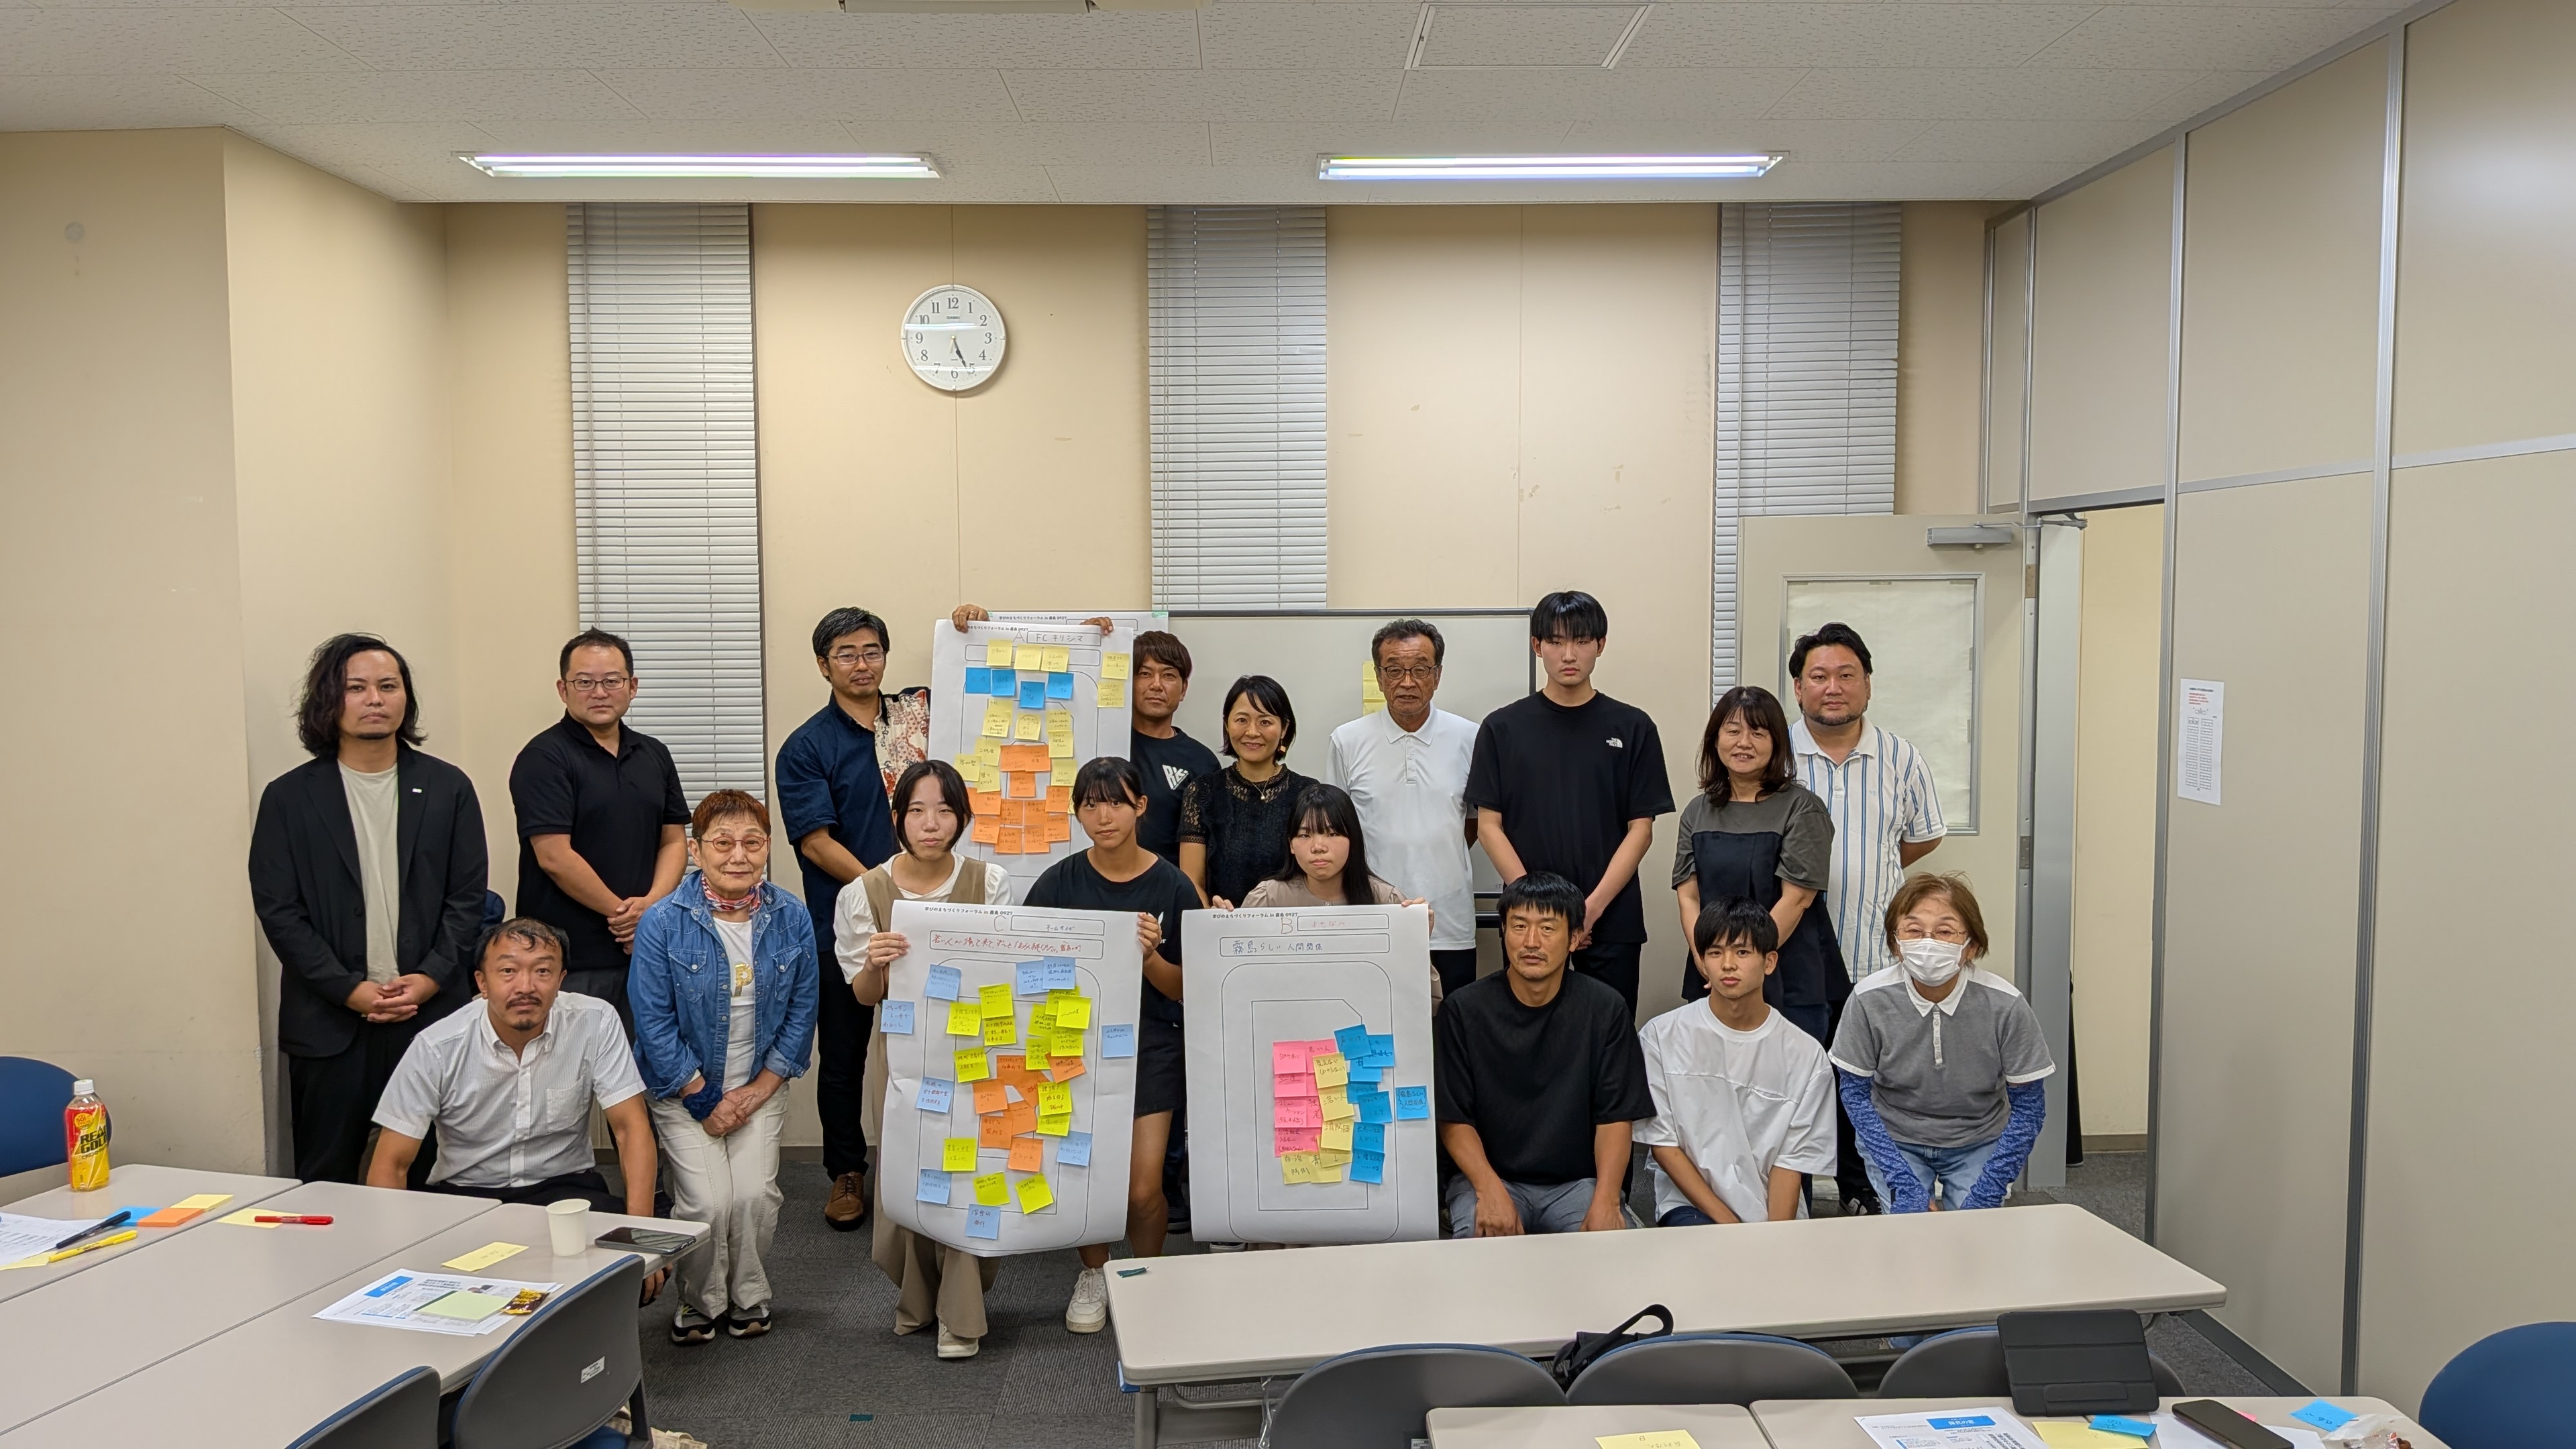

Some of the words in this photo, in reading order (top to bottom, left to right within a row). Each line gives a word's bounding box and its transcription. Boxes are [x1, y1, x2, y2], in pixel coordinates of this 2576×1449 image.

[932, 302, 941, 313] 11
[947, 297, 959, 309] 12
[968, 302, 973, 313] 1
[920, 315, 930, 325] 10
[979, 315, 987, 326] 2
[916, 332, 923, 344] 9
[984, 333, 992, 344] 3
[920, 350, 928, 361] 8
[979, 350, 986, 361] 4
[934, 363, 941, 374] 7
[951, 368, 959, 379] 6
[969, 363, 975, 374] 5
[1012, 630, 1025, 642] A
[1036, 633, 1048, 642] FC
[1053, 634, 1083, 643] キリシマ
[994, 915, 1006, 932] C
[1281, 917, 1293, 934] B
